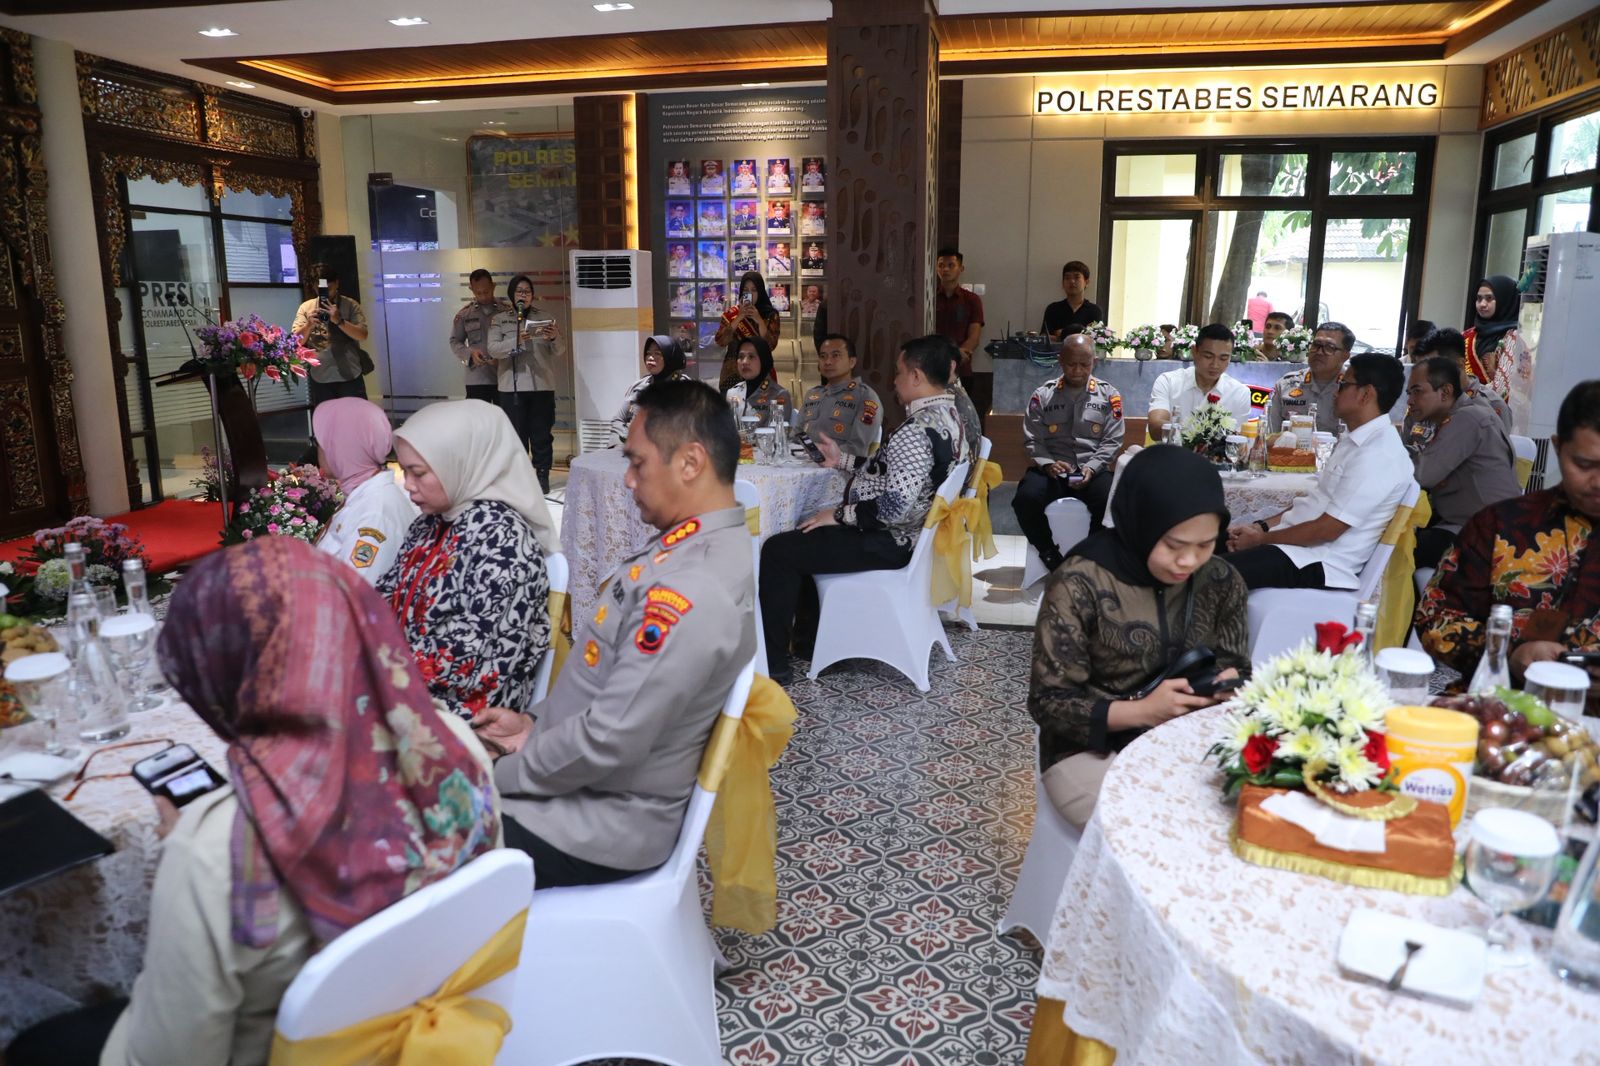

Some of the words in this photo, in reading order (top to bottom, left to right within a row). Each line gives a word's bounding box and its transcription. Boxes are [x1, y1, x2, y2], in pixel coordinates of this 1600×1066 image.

[1037, 86, 1253, 113] POLRESTABES
[1261, 83, 1438, 108] SEMARANG
[835, 400, 856, 410] POLRI
